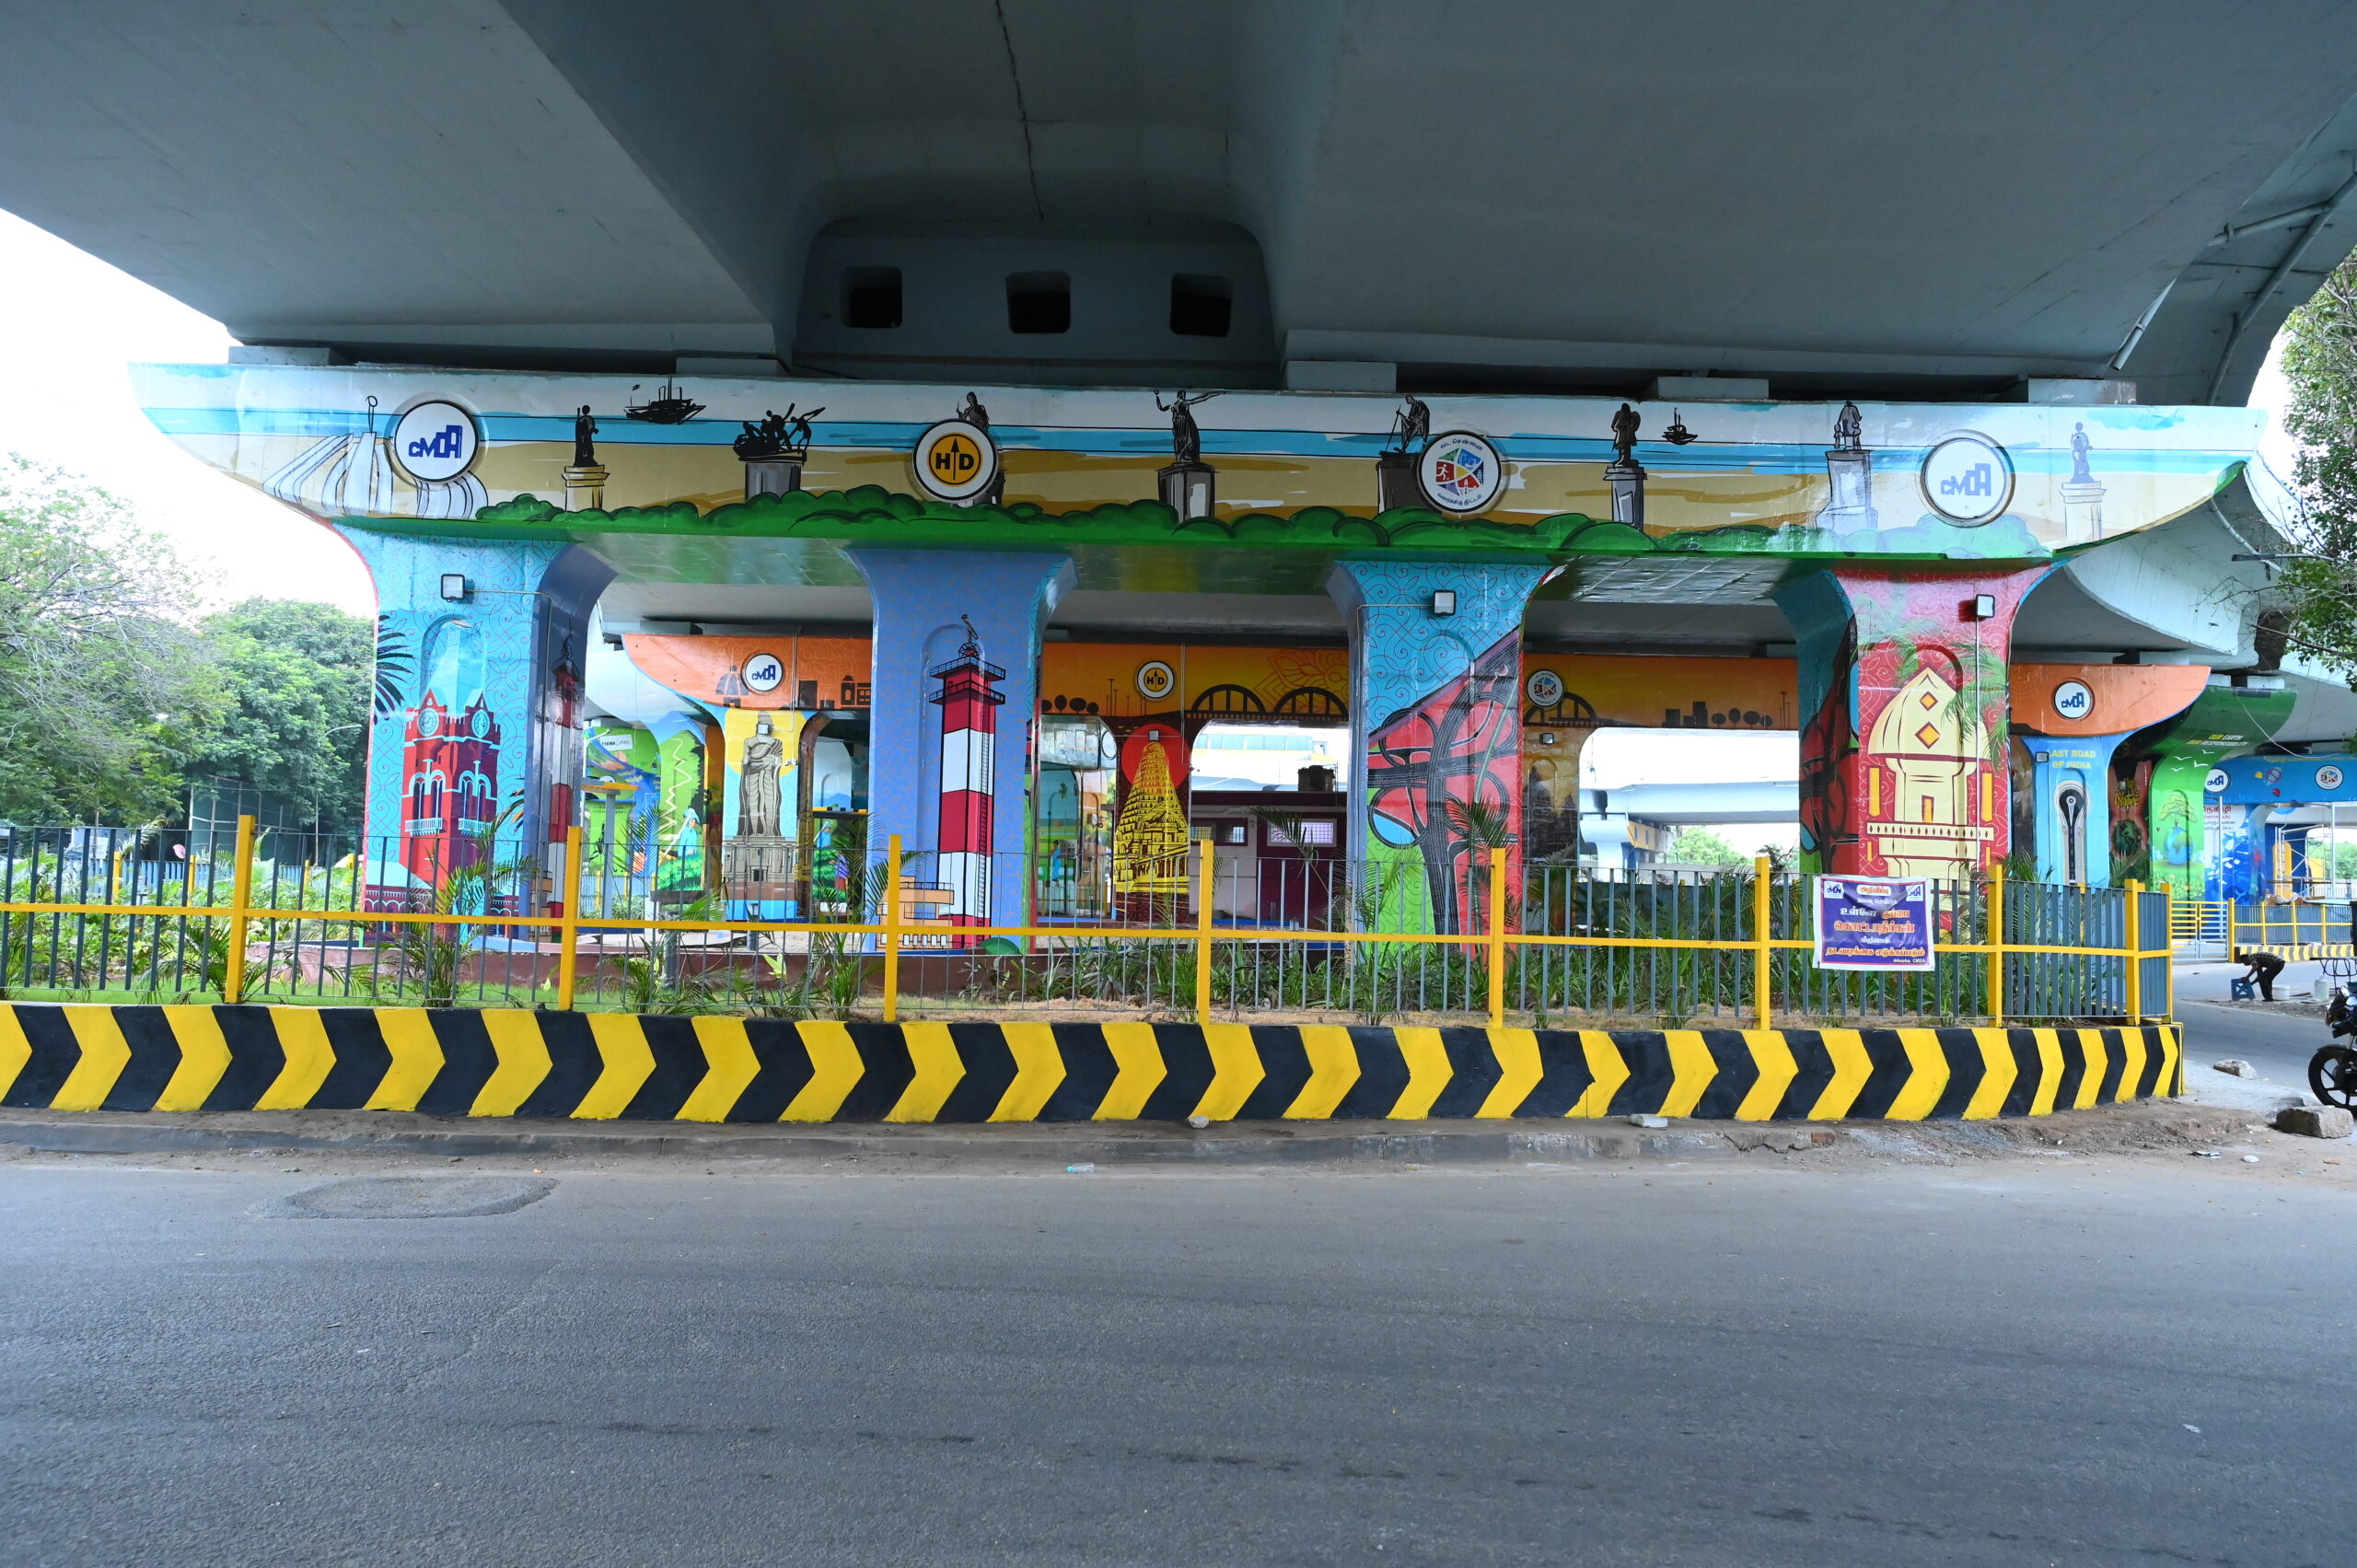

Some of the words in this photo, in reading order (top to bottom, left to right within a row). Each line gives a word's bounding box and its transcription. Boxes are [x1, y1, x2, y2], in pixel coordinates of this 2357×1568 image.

[1452, 438, 1483, 451] சென்னை
[2071, 749, 2096, 758] ROAD
[2052, 761, 2064, 769] OF
[2067, 761, 2092, 769] INDIA
